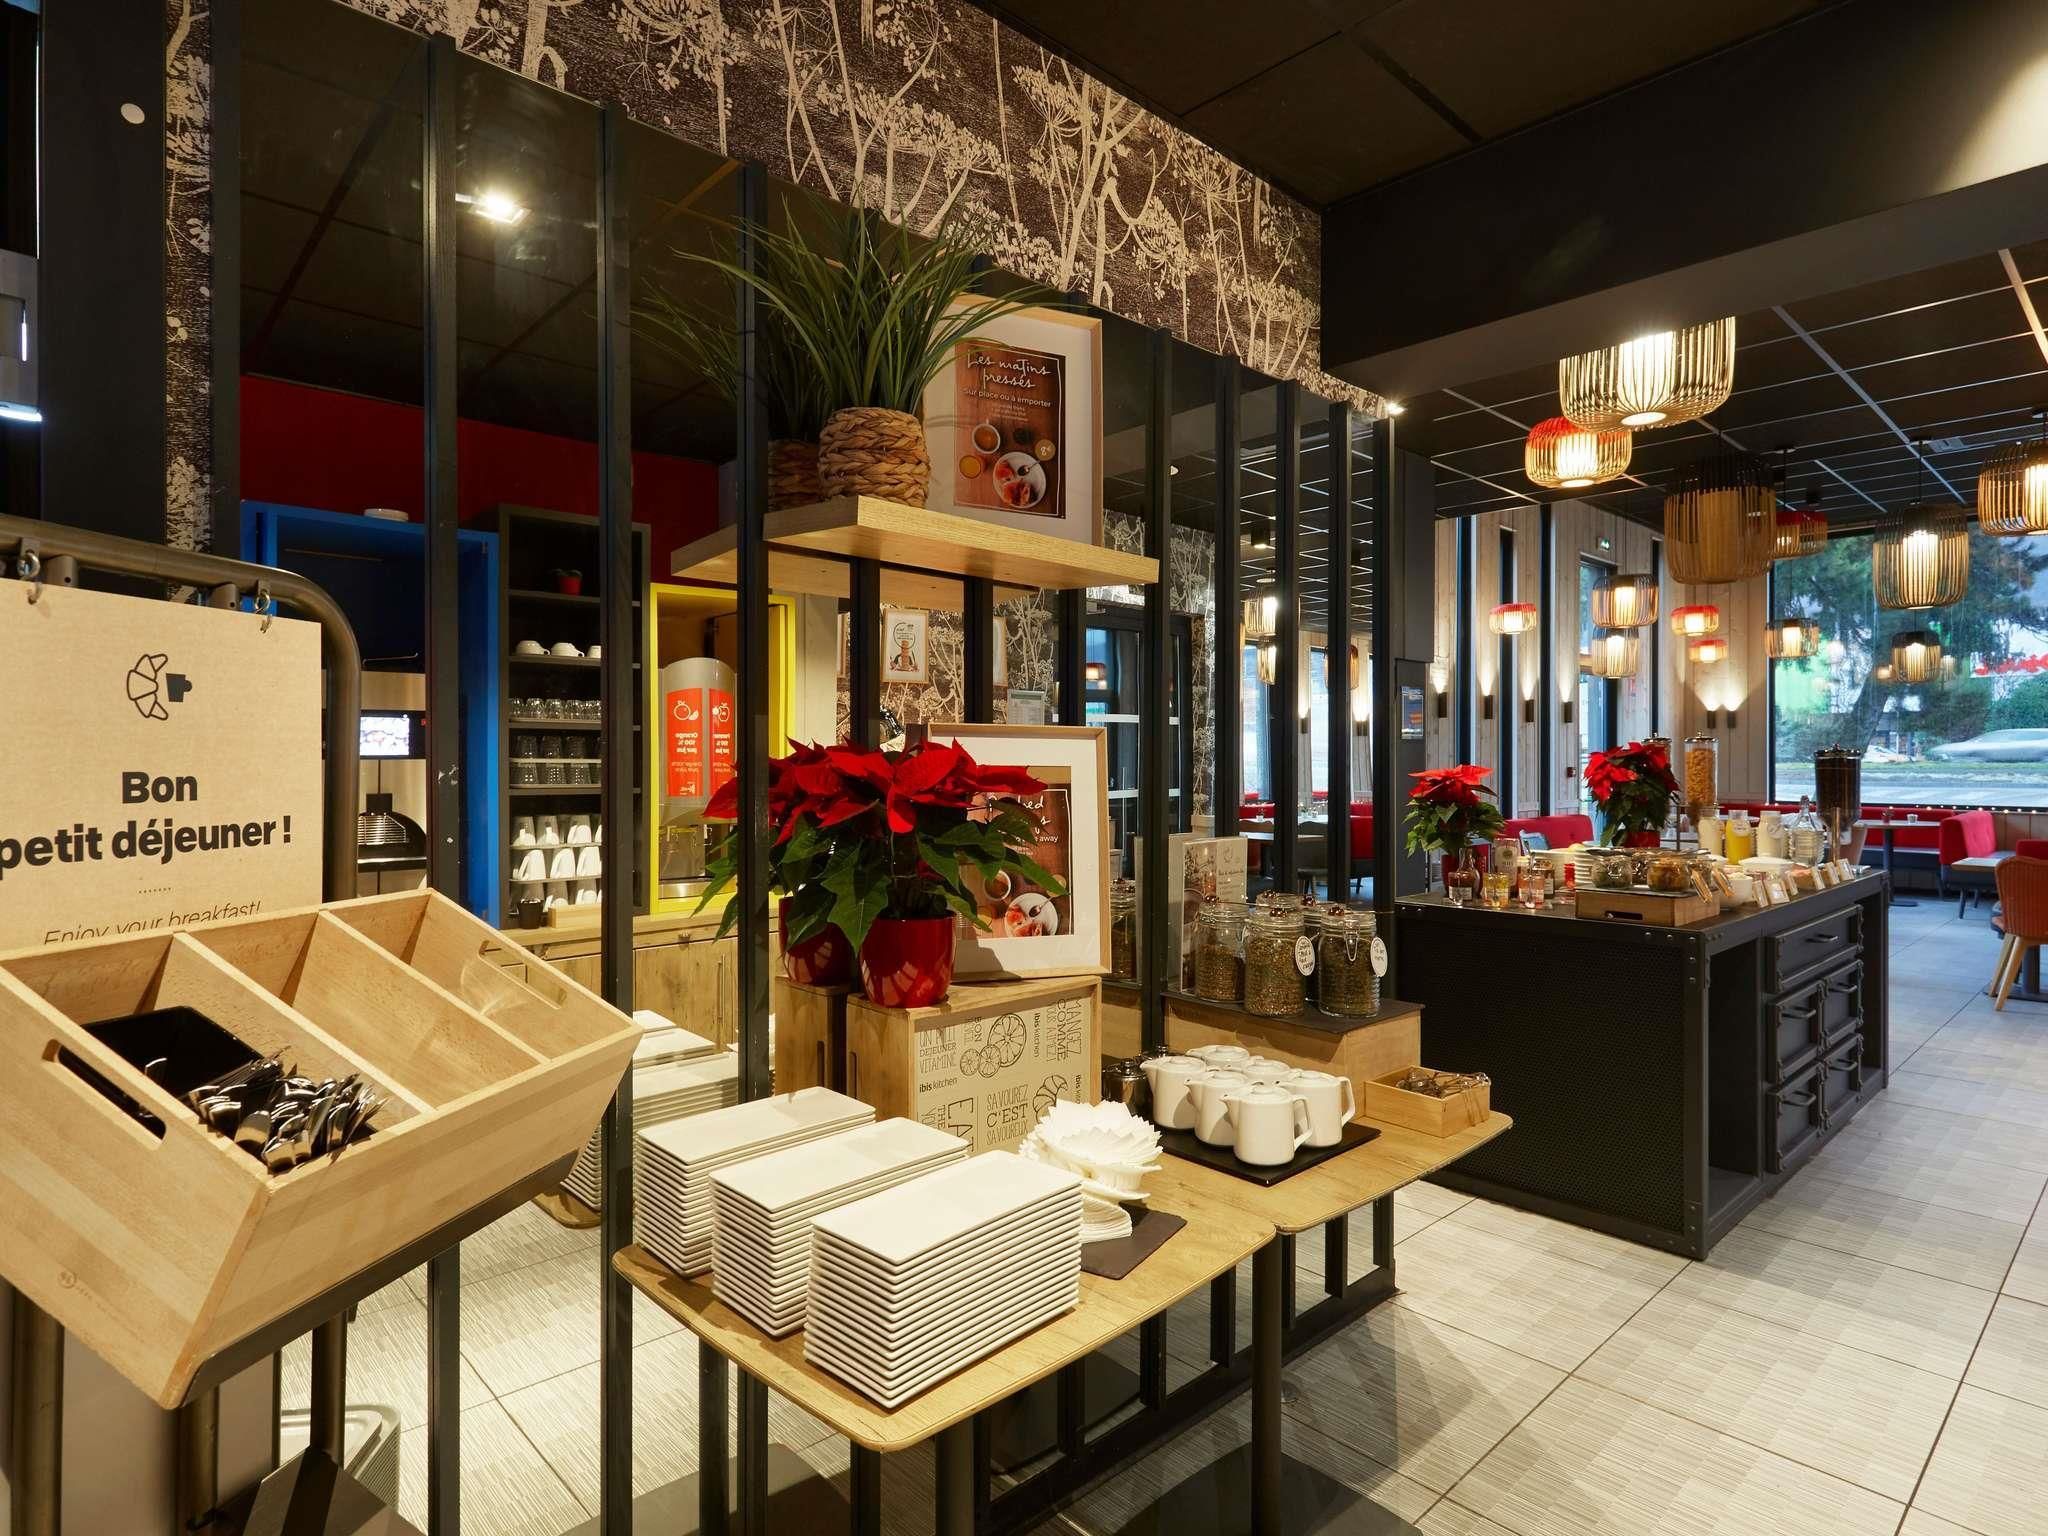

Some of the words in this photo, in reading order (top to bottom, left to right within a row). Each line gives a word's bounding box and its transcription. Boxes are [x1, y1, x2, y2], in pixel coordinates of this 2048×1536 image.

[968, 350, 995, 368] Les
[999, 358, 1052, 377] matins
[983, 368, 1036, 390] pressés
[978, 390, 998, 400] place
[122, 771, 198, 804] Bon
[0, 823, 103, 881] petit
[111, 818, 277, 865] déjeuner
[1033, 1012, 1041, 1028] ibis
[1056, 998, 1069, 1062] COMME
[919, 1081, 932, 1094] ibis
[932, 1076, 958, 1091] kitchen
[986, 1102, 1028, 1128] C'EST
